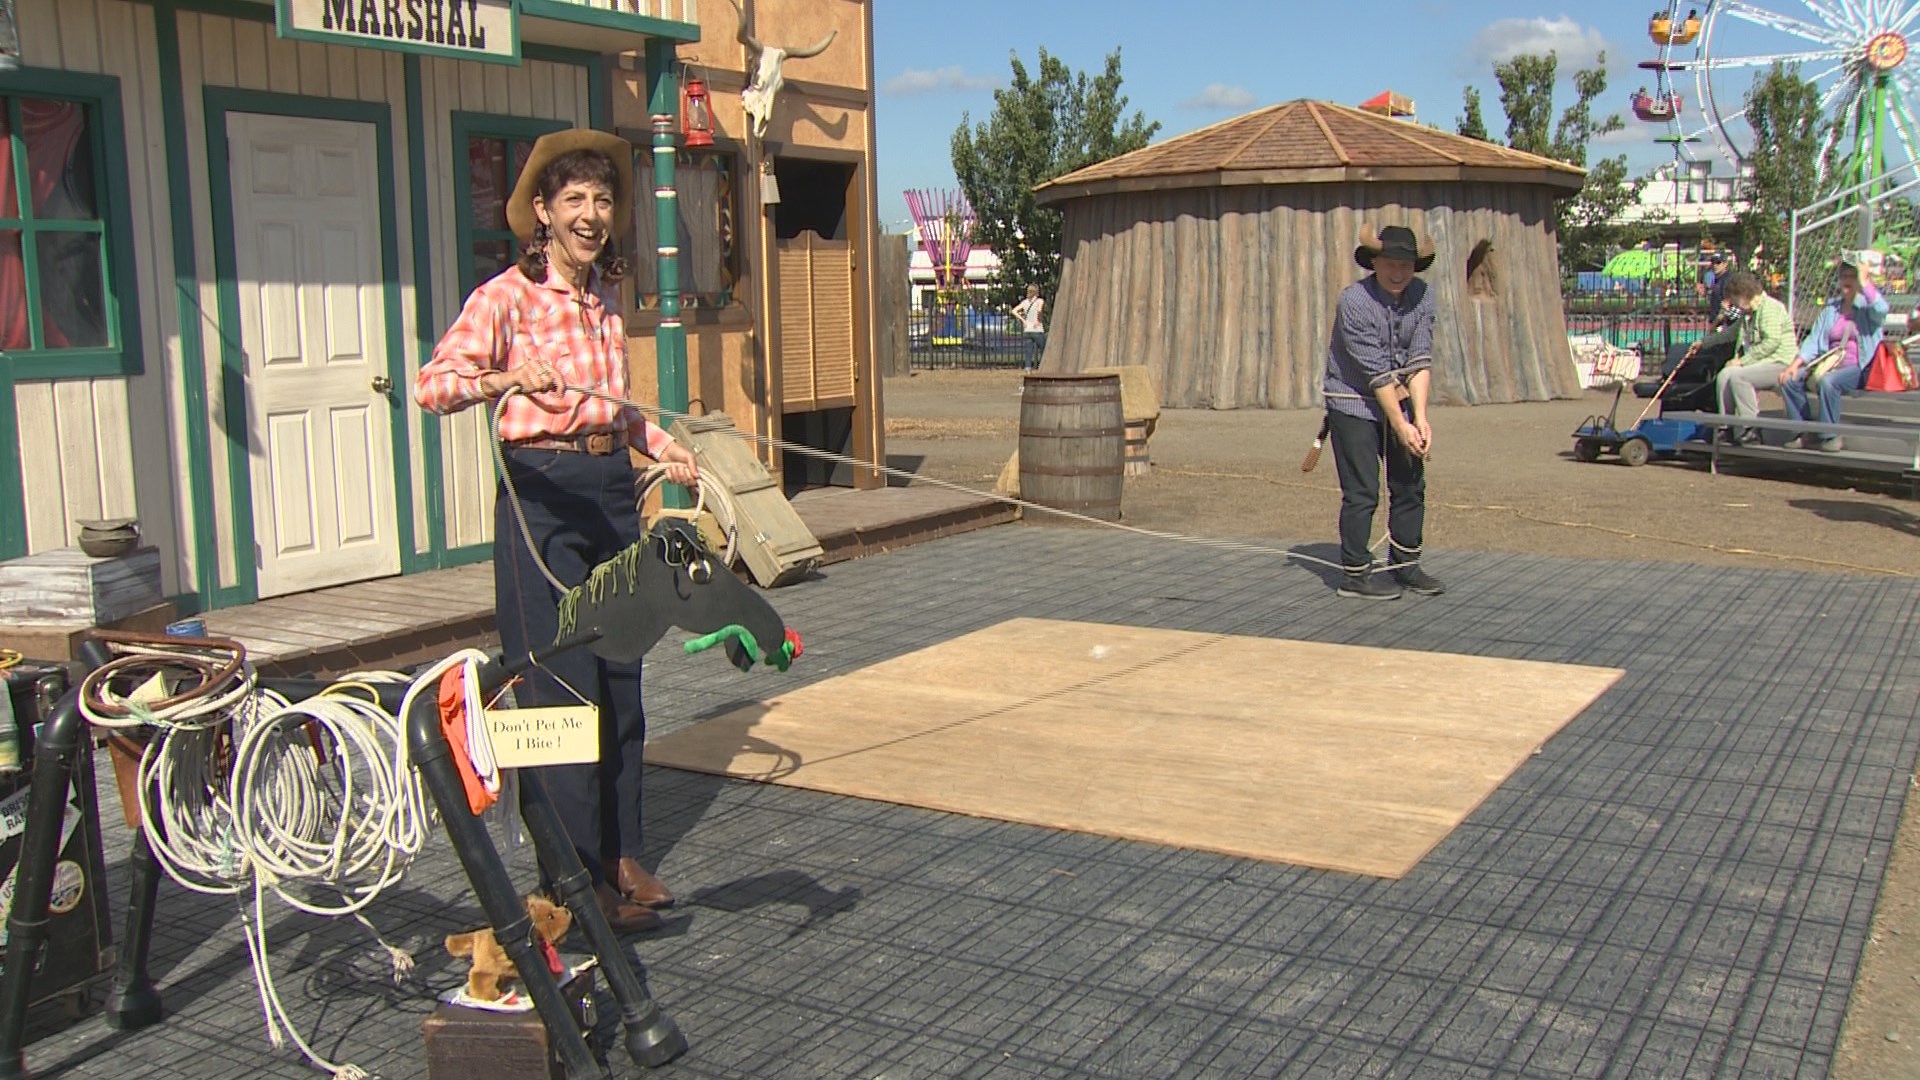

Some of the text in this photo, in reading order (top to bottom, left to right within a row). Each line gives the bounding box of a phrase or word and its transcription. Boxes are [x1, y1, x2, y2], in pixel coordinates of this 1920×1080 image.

[322, 0, 486, 49] MARSHAL
[493, 717, 583, 733] Don't Pet Me
[526, 737, 553, 749] Bite
